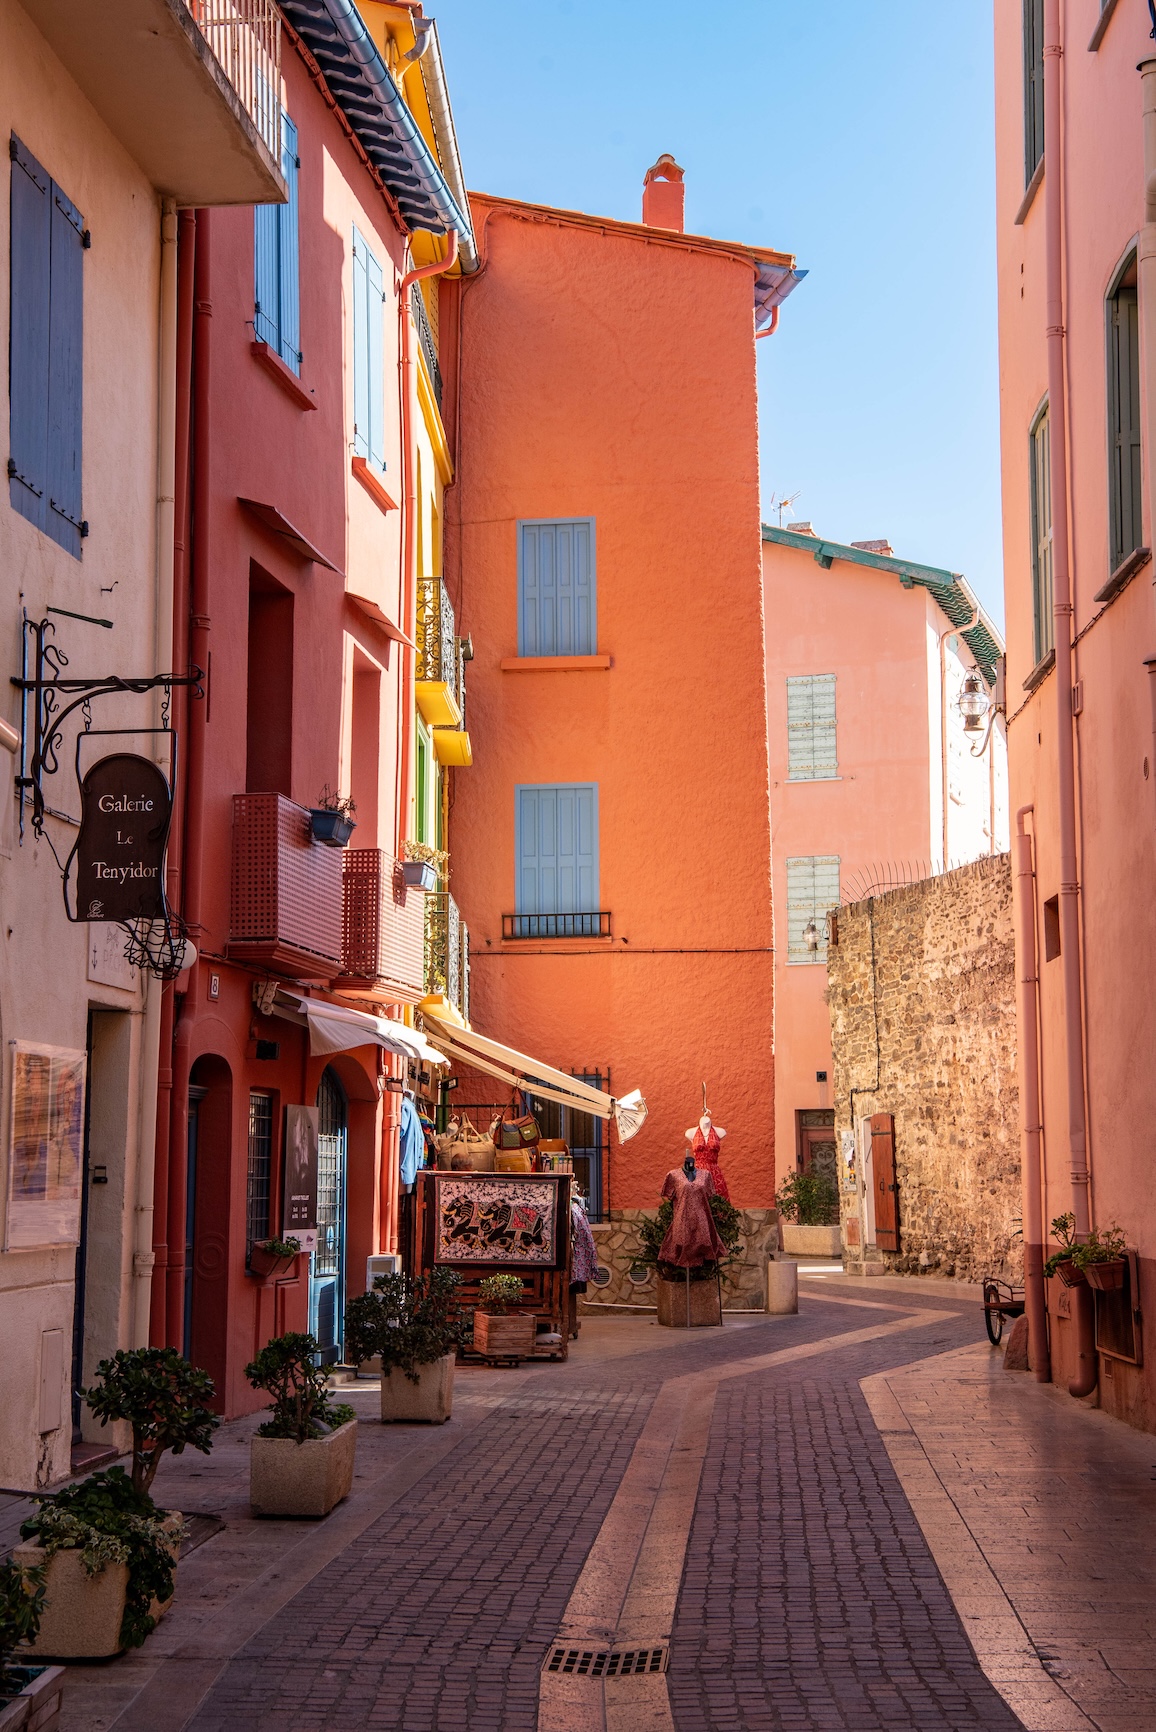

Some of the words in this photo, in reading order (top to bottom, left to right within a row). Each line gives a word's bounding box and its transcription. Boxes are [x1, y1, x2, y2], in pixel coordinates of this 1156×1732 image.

[98, 794, 154, 813] Galerie
[117, 831, 134, 845] Le
[91, 861, 158, 885] Tenyidor
[212, 978, 218, 993] 8
